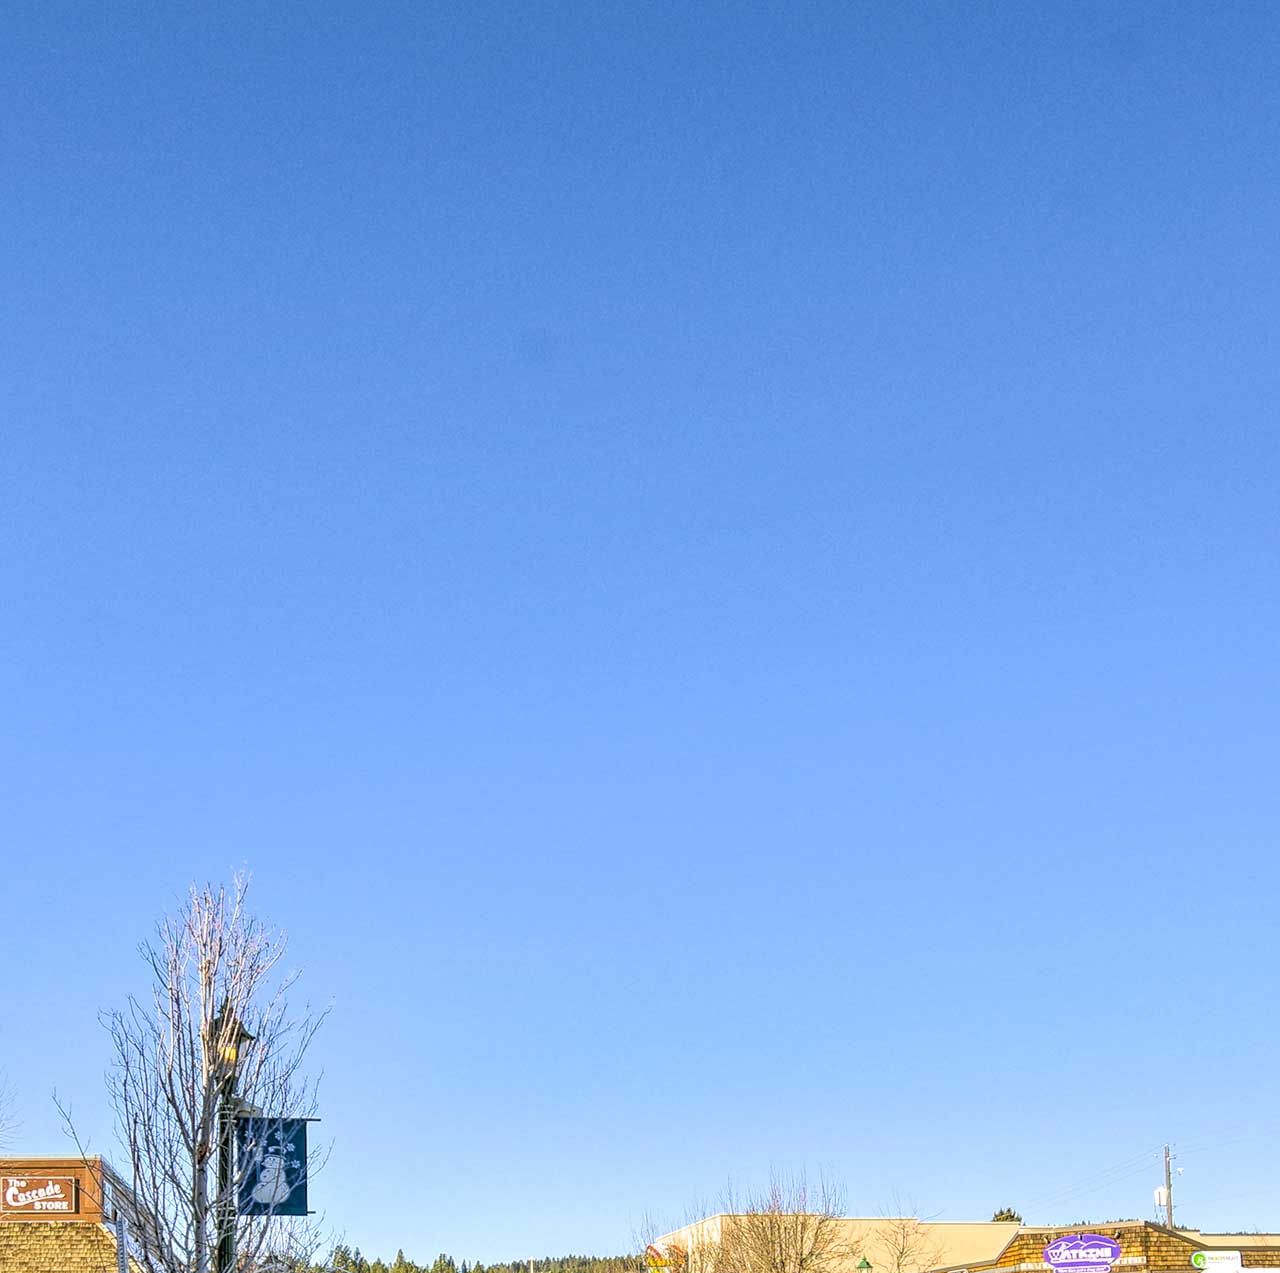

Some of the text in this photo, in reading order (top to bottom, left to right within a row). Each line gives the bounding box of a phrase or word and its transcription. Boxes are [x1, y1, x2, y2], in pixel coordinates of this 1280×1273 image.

[8, 1179, 27, 1187] The
[6, 1181, 65, 1206] Cascade
[34, 1202, 68, 1210] STORE
